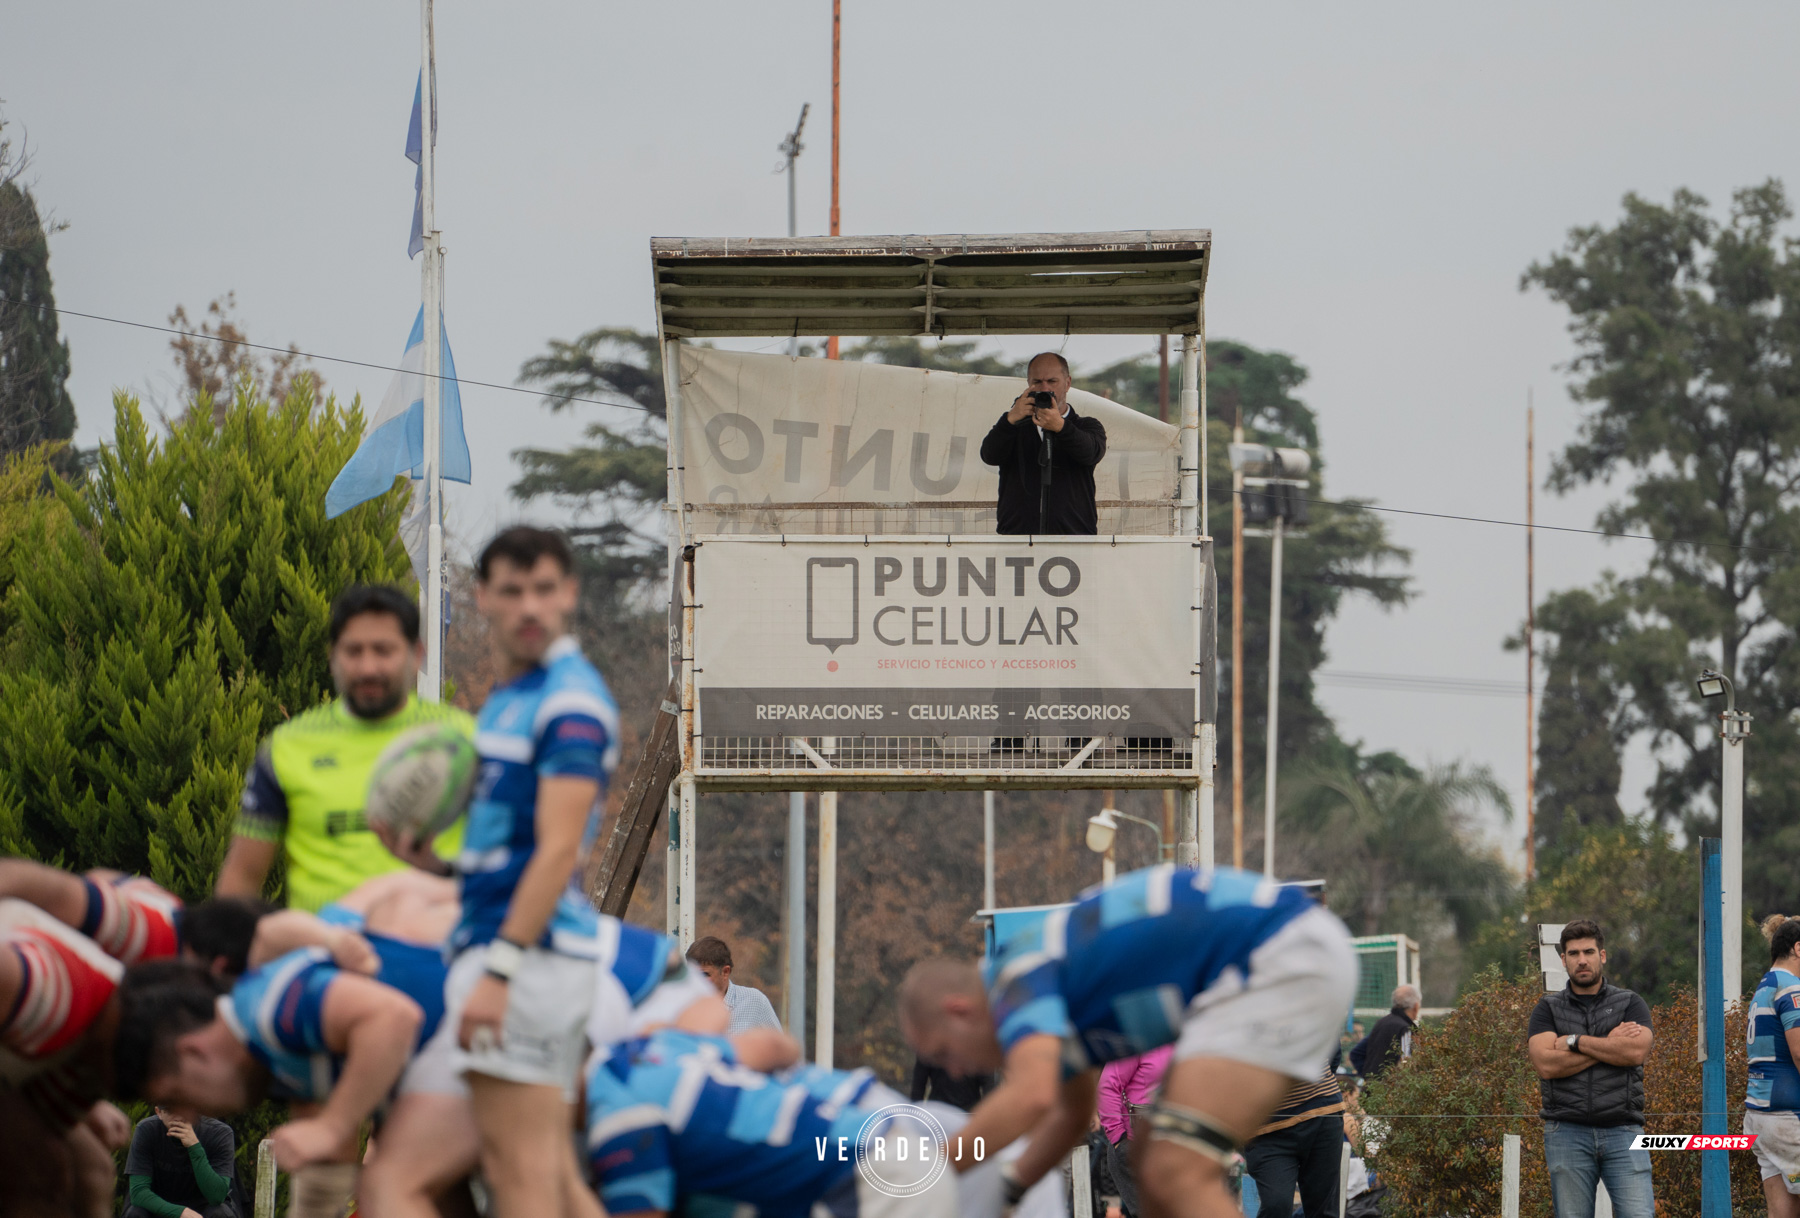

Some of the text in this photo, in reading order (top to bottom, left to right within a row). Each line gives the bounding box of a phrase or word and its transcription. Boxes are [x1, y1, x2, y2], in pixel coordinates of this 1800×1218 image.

[874, 556, 1081, 597] PUNTO
[873, 605, 1079, 646] CELULAR
[877, 657, 1077, 670] SERVICIO TÉCNICO Y ACCESORIOS
[756, 704, 884, 720] REPARACIONES
[908, 704, 999, 720] CELULARES
[1024, 704, 1131, 720] ACCESORIOS
